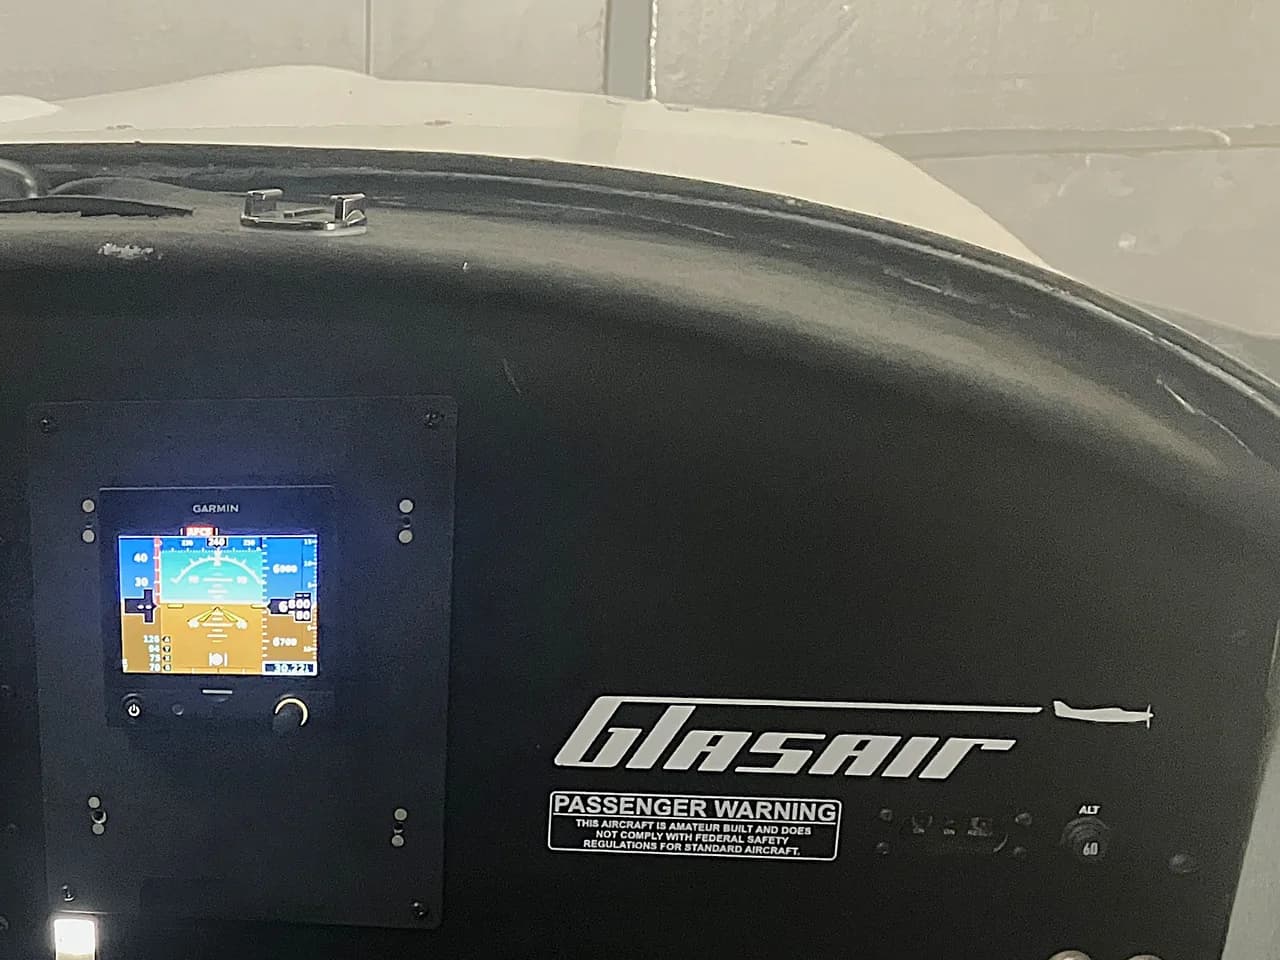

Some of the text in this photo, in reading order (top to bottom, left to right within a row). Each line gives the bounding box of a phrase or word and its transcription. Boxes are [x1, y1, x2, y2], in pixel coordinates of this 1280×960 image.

[193, 504, 239, 513] GARMIN
[133, 553, 148, 562] 40
[134, 577, 148, 587] 30
[554, 794, 836, 821] PASSENGER WARNING
[1079, 805, 1100, 815] ALT
[575, 818, 811, 836] THIS AIRCRAFT IS AMATEUR BUILT AND DOES
[595, 829, 789, 845] NOT COMPLY WITH FEDERAL SAFETY
[583, 839, 801, 856] REGULATIONS FOR STANDARD AIRCRAFT.
